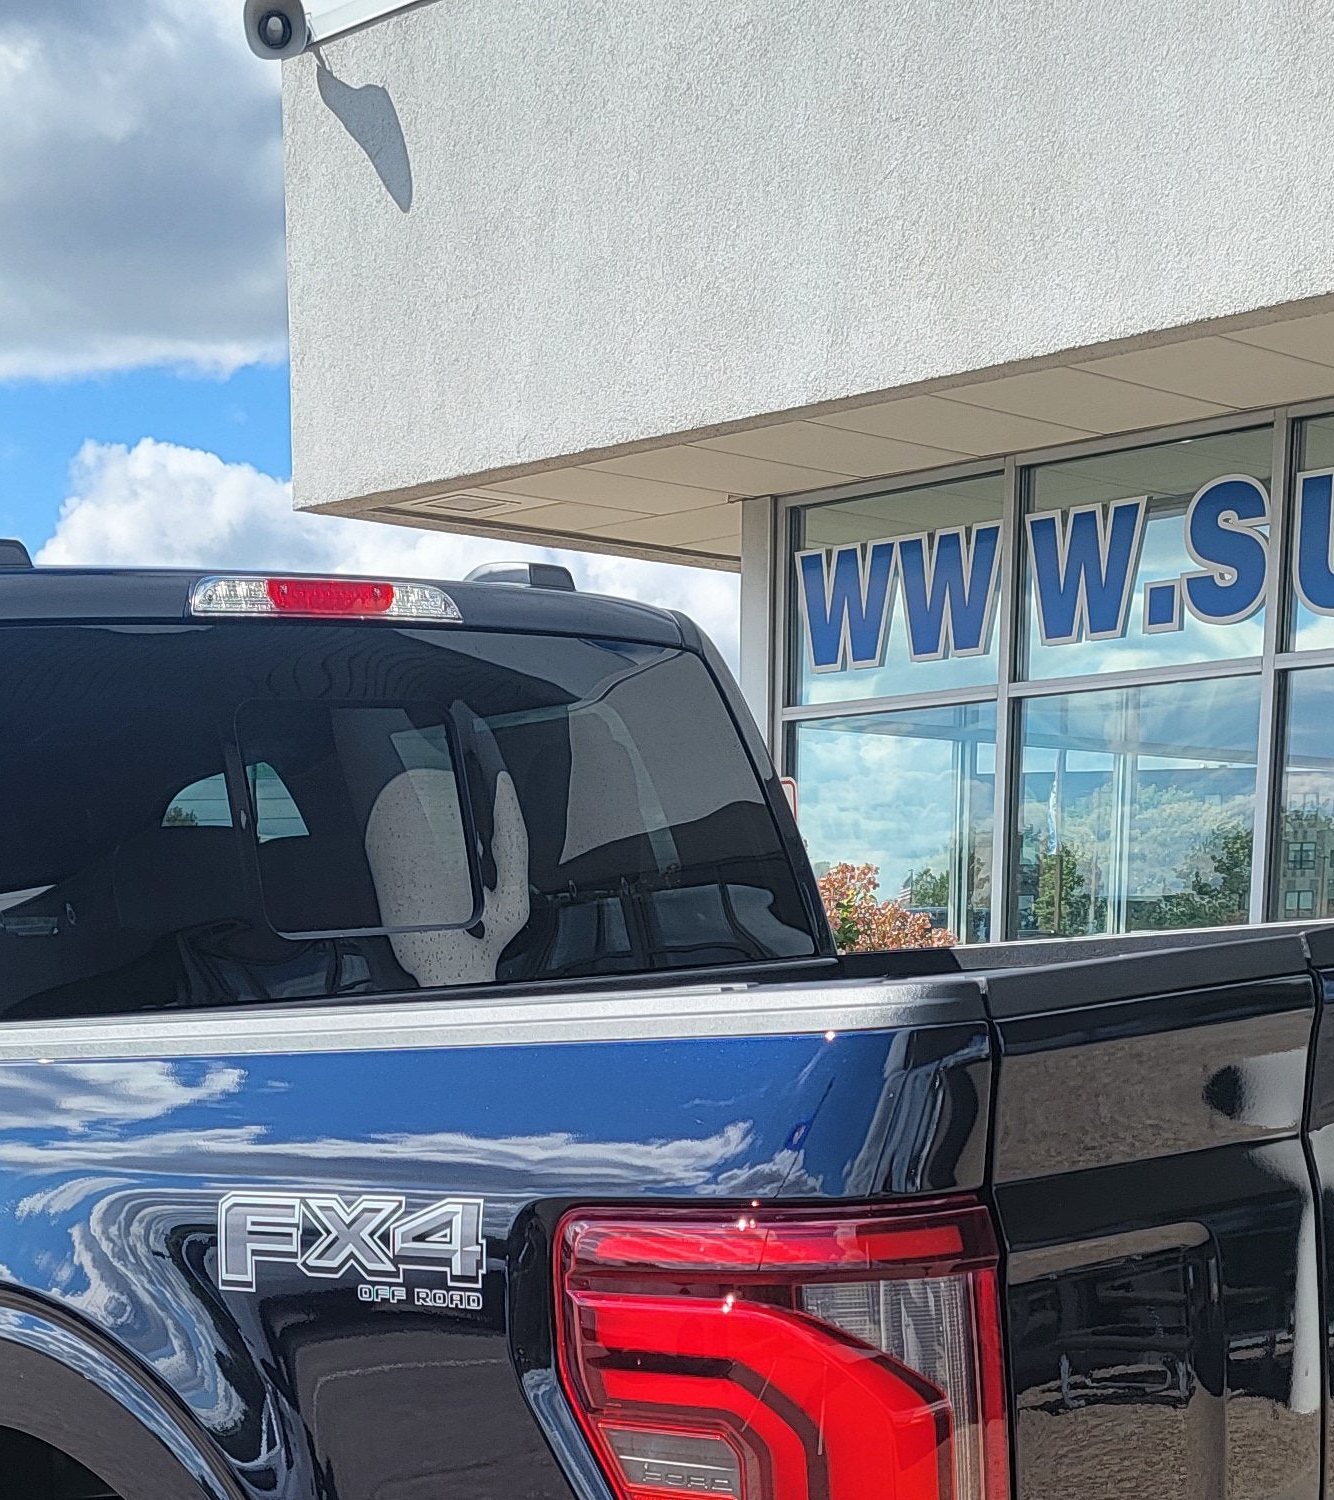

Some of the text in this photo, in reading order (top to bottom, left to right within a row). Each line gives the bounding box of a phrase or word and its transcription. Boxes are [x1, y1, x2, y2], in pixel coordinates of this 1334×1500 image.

[218, 1190, 487, 1292] FX4
[357, 1284, 483, 1310] OFF ROAD
